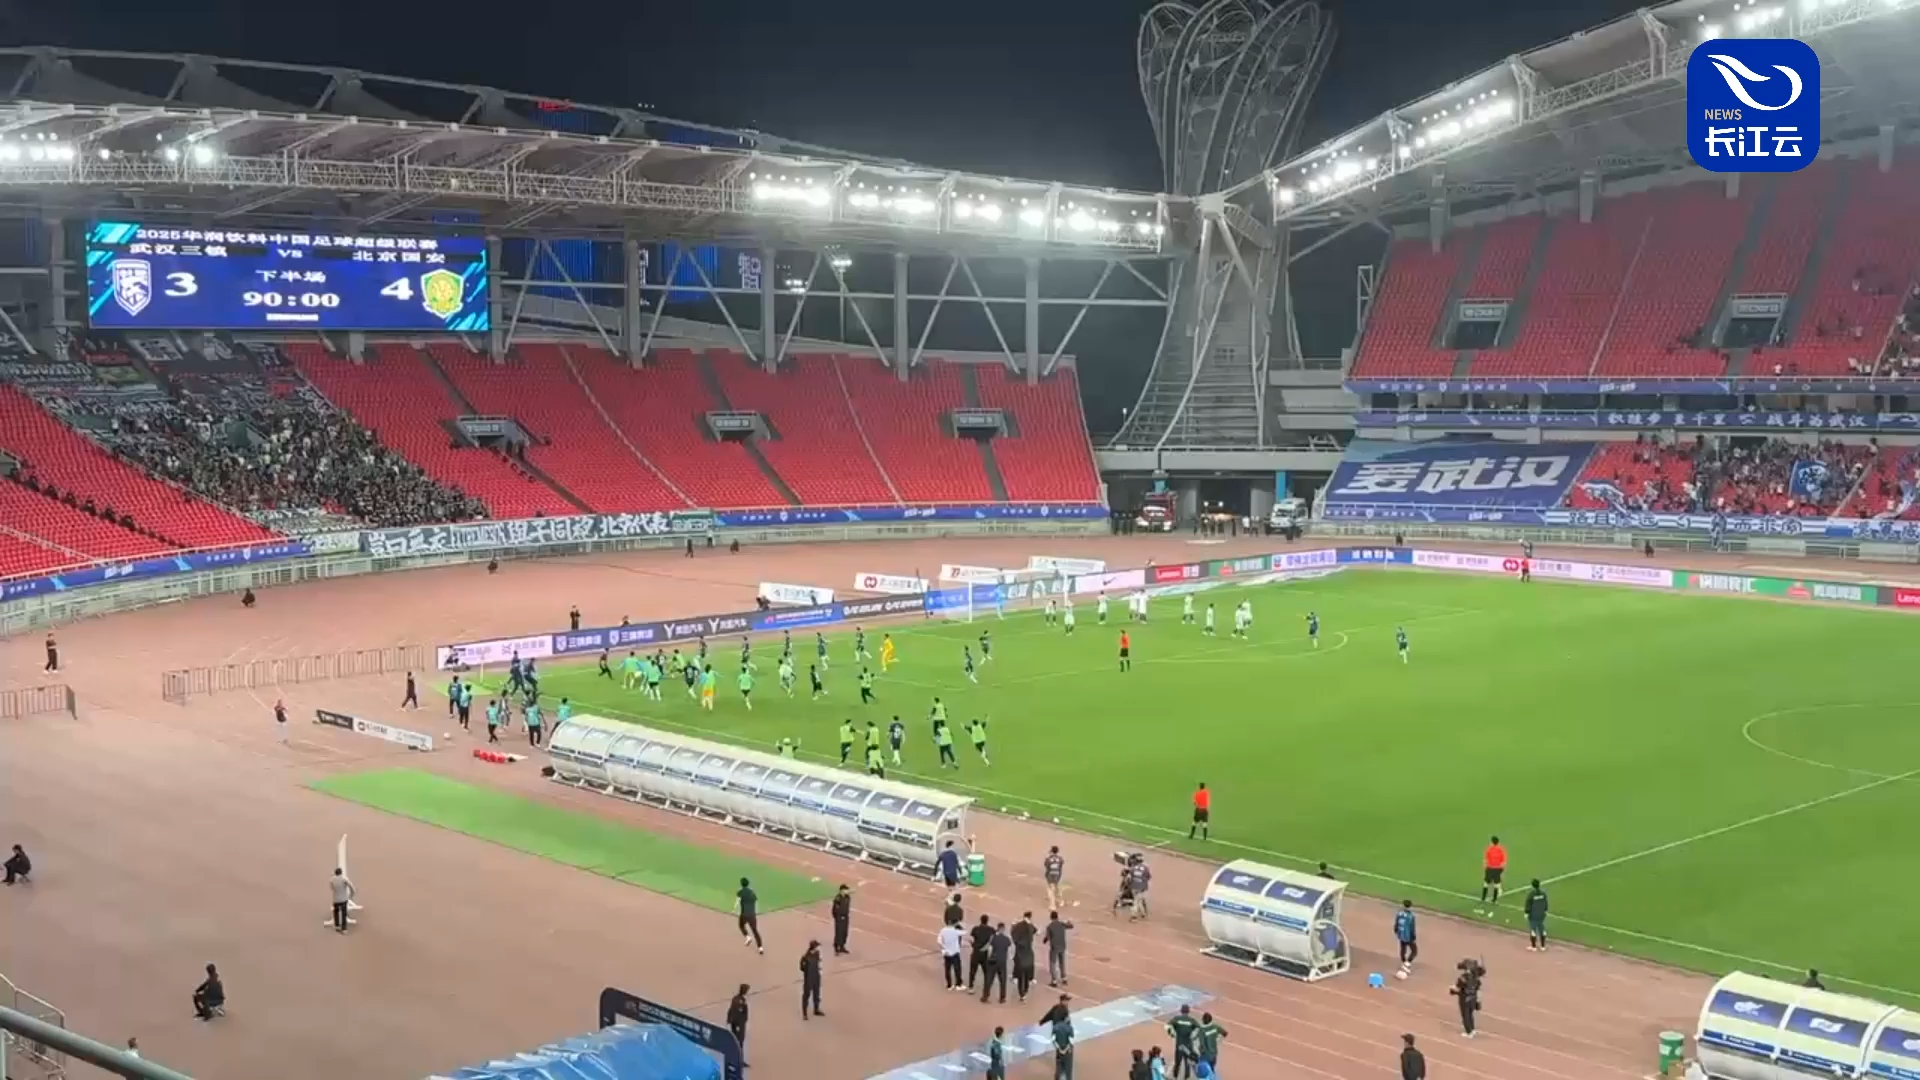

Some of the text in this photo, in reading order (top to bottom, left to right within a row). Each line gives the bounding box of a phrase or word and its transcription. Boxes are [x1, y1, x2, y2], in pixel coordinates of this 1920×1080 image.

[129, 243, 227, 257] 武汉三镇
[352, 251, 445, 263] 北京国安
[164, 272, 198, 296] 3
[255, 270, 326, 283] 下半场
[243, 291, 340, 307] 90:00
[380, 277, 414, 300] 4
[1334, 456, 1570, 494] 爱武汉
